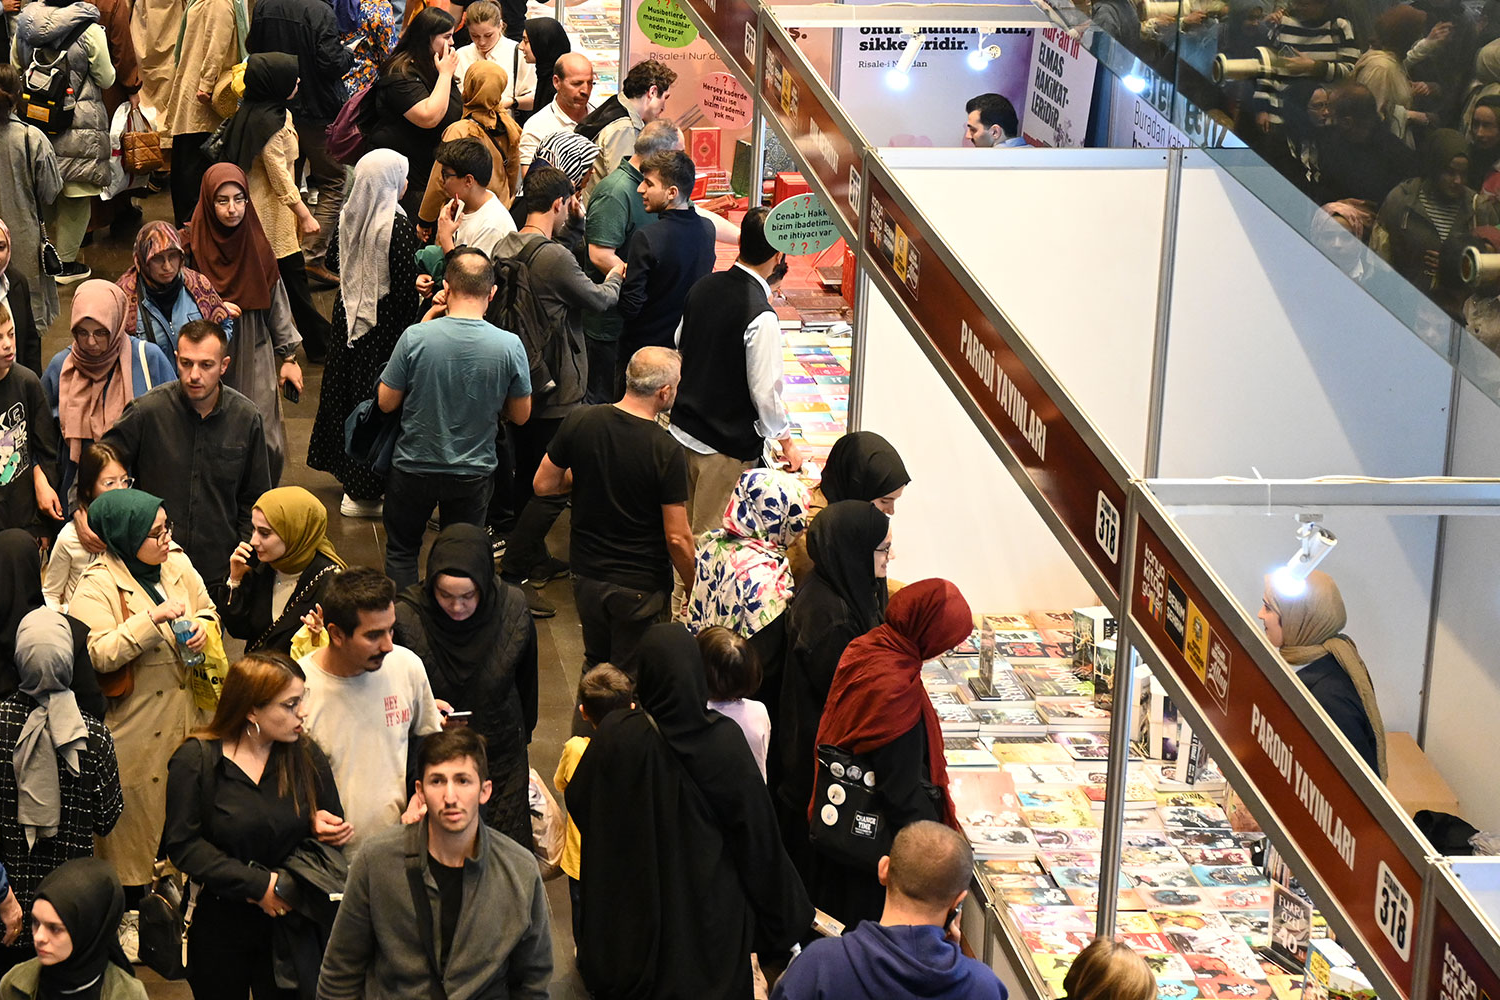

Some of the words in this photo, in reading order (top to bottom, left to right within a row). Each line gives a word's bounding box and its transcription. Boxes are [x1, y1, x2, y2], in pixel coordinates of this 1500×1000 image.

[647, 6, 687, 21] Musibetlerde
[643, 13, 666, 24] masum
[665, 18, 691, 29] insanlar
[648, 22, 668, 32] neden
[667, 27, 685, 36] zarar
[654, 31, 678, 42] görüyor
[859, 38, 968, 51] sikkeridir.
[858, 60, 890, 68] Risale-i
[1038, 41, 1065, 78] ELMAS
[723, 87, 748, 101] kaderde
[703, 99, 720, 110] bizim
[728, 99, 737, 107] ise
[713, 111, 724, 120] yok
[771, 222, 793, 231] bizim
[789, 231, 818, 242] ihtiyacı
[819, 229, 833, 237] var
[961, 319, 996, 394] PARODİ
[996, 361, 1048, 461] YAYINLARI
[1098, 510, 1116, 556] 318
[1145, 542, 1165, 581] konya
[1143, 558, 1164, 600] kitap
[384, 695, 398, 711] HEY
[1251, 704, 1294, 795] PARODİ
[1294, 758, 1356, 871] YAYINLARI
[856, 814, 876, 825] CHANGE
[857, 821, 872, 831] TIME
[1380, 887, 1405, 949] 318
[1276, 928, 1297, 954] 40
